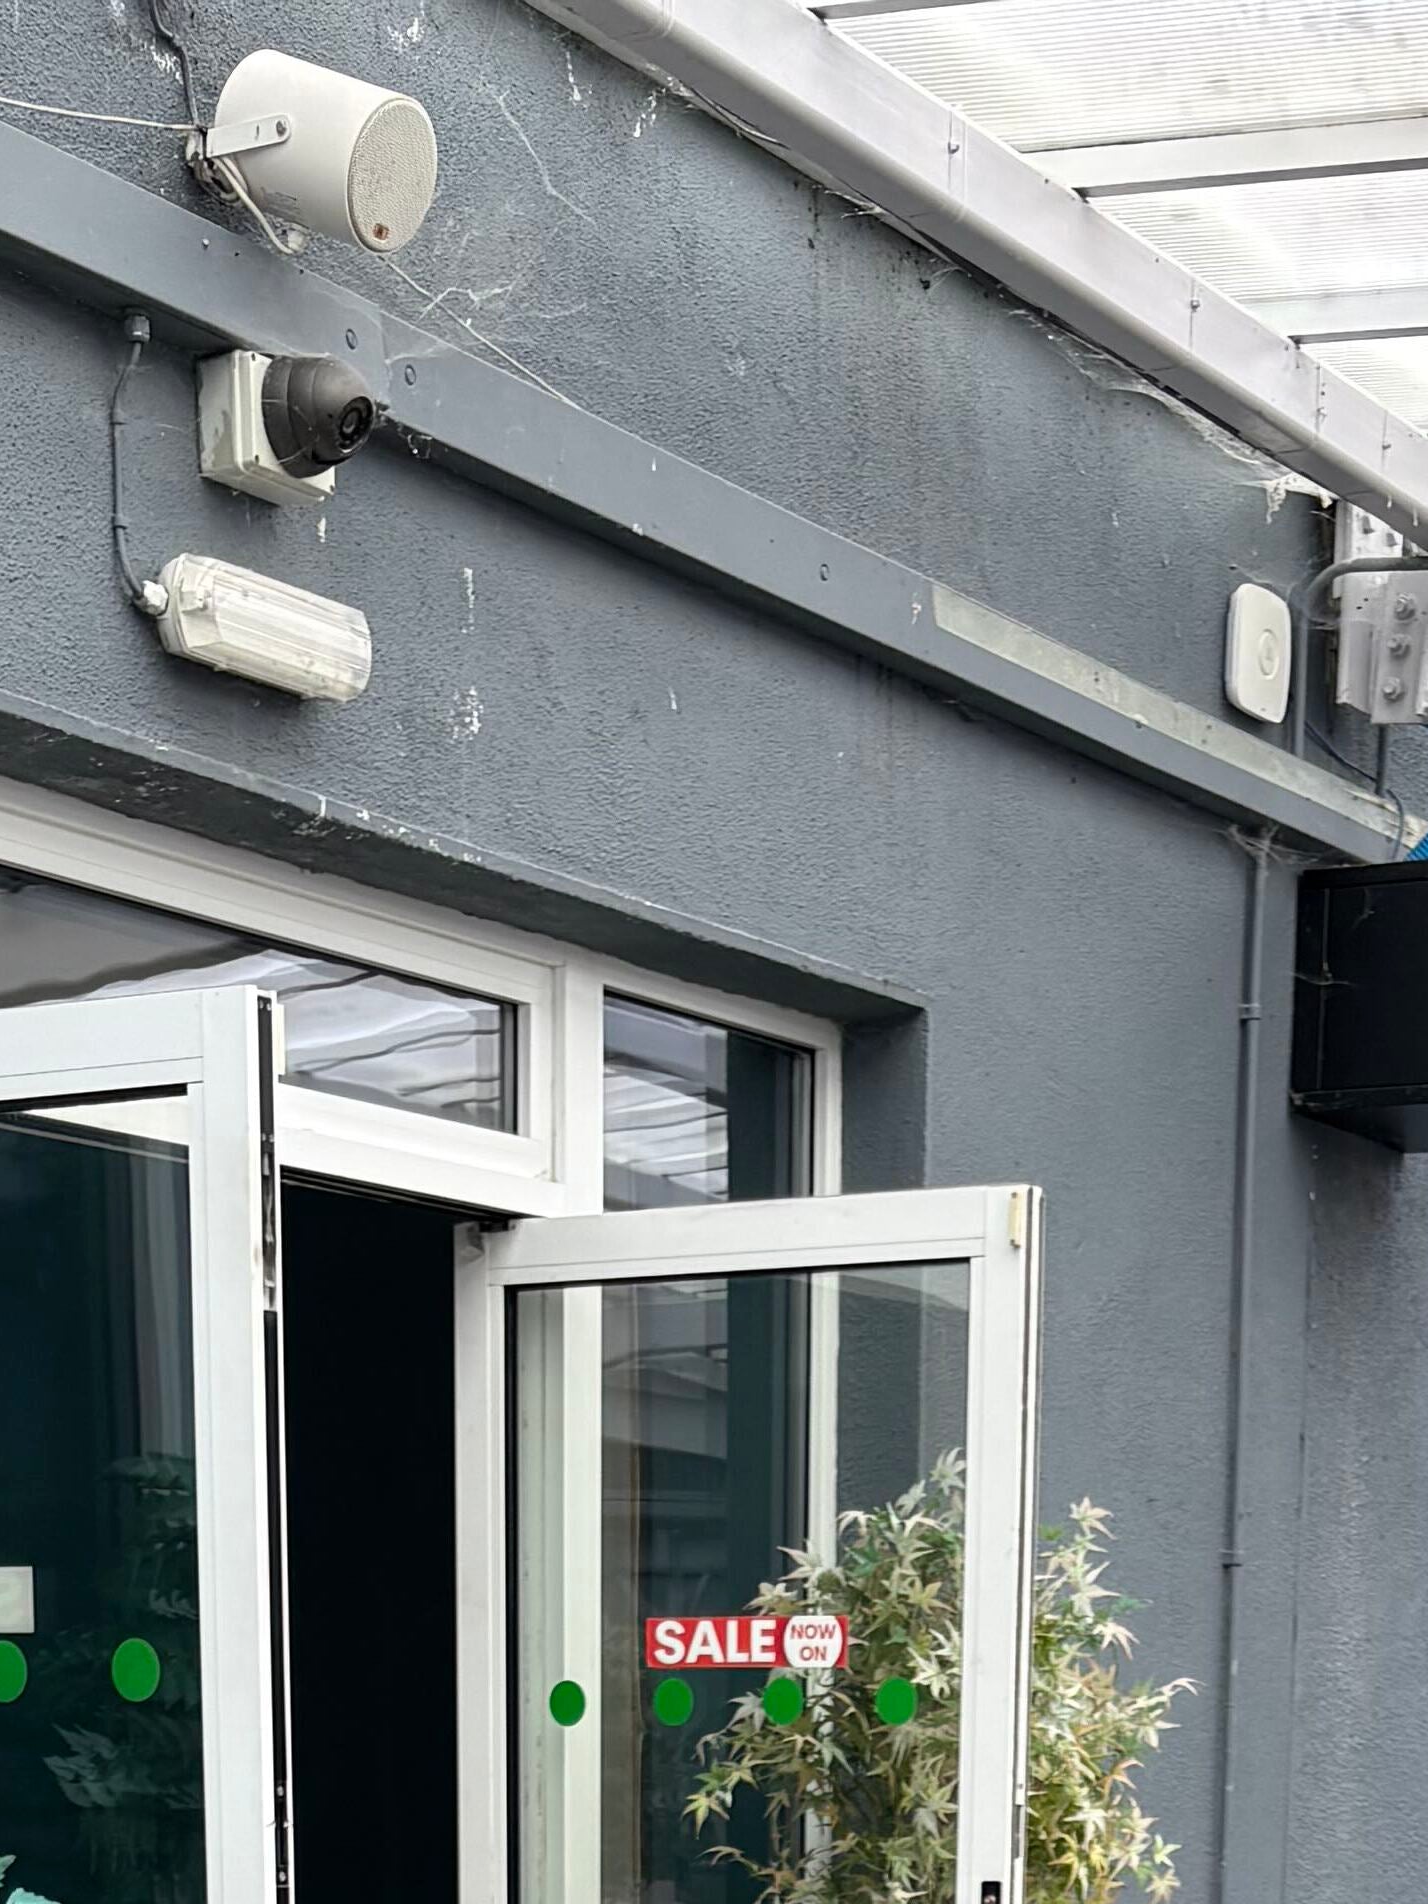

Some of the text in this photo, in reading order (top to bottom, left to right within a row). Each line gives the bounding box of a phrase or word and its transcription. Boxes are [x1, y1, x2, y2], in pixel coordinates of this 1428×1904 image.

[790, 1623, 838, 1640] NOW
[654, 1619, 777, 1665] SALE
[799, 1645, 828, 1662] ON
